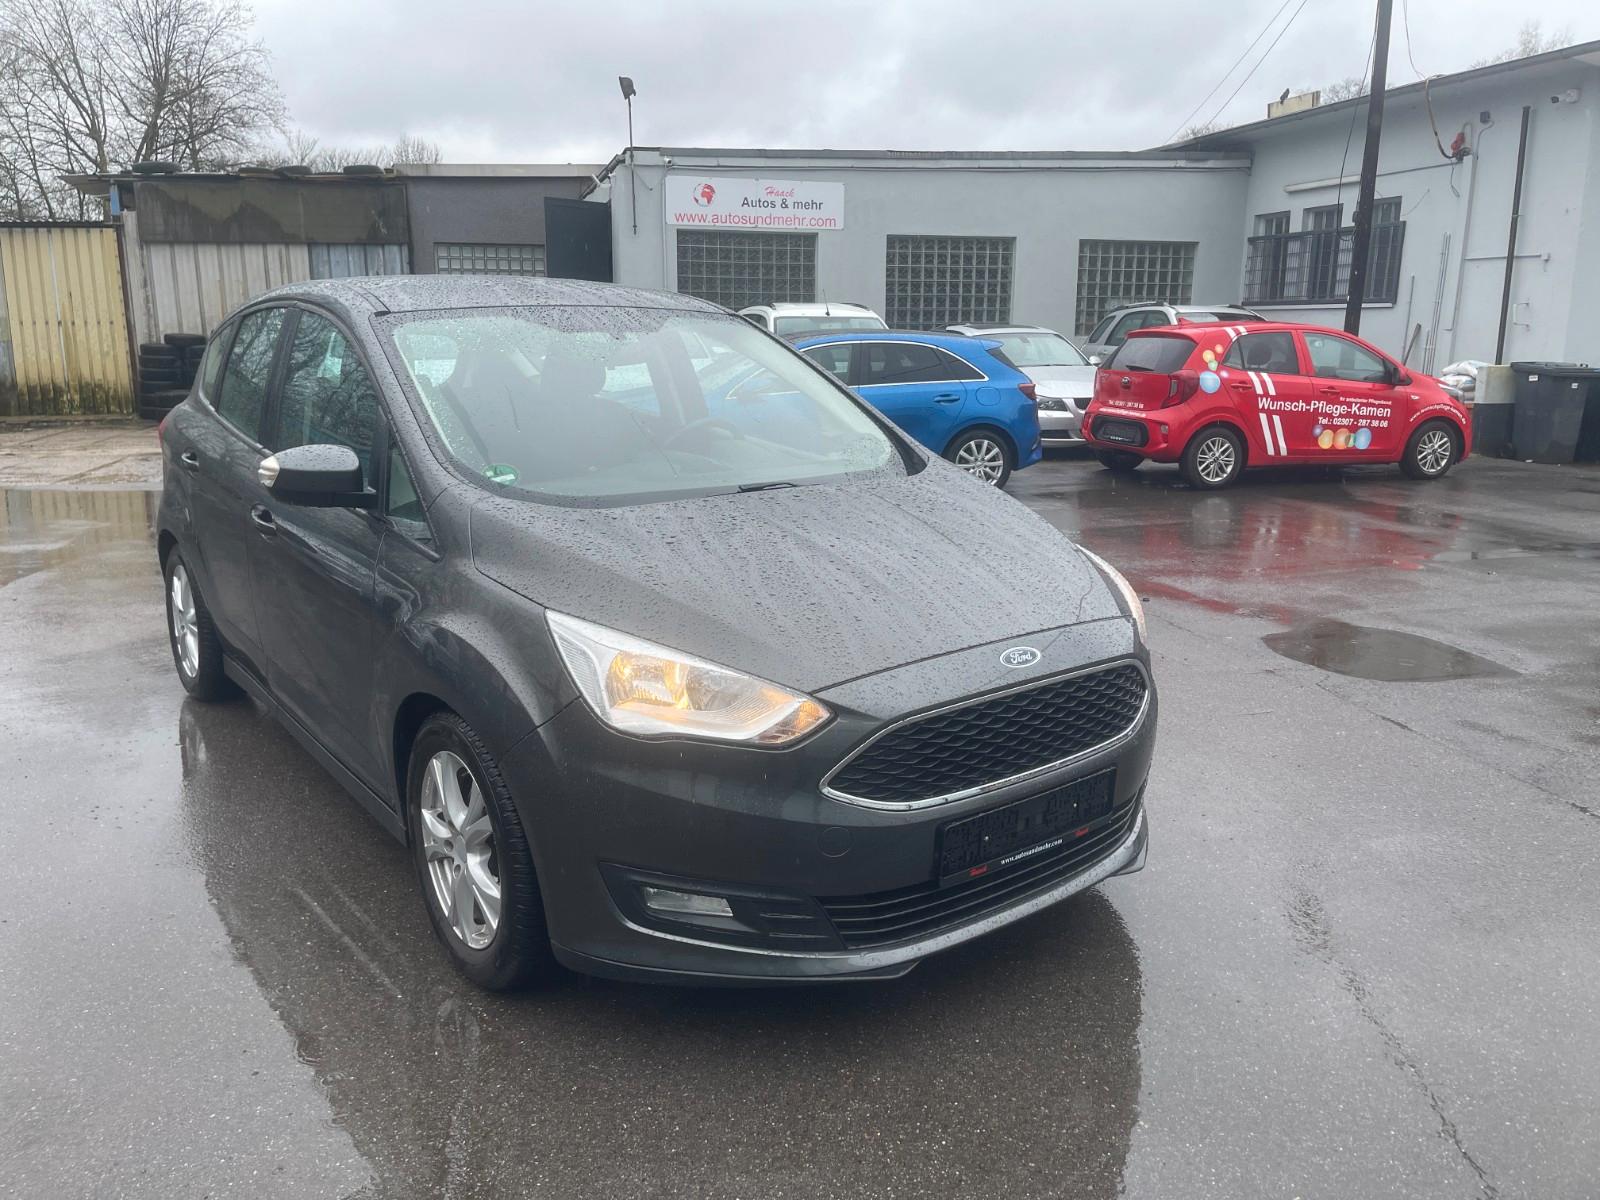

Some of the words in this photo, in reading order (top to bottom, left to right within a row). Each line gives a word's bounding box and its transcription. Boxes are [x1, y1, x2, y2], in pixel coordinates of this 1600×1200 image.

[741, 197, 776, 209] Autos
[780, 198, 789, 209] &
[792, 199, 824, 211] mehr
[674, 212, 837, 228] www.autosundmehr.com
[1258, 397, 1391, 417] Wunsch-Pflege-Kamen
[1318, 417, 1332, 425] Tel.:
[1010, 650, 1033, 664] Ford
